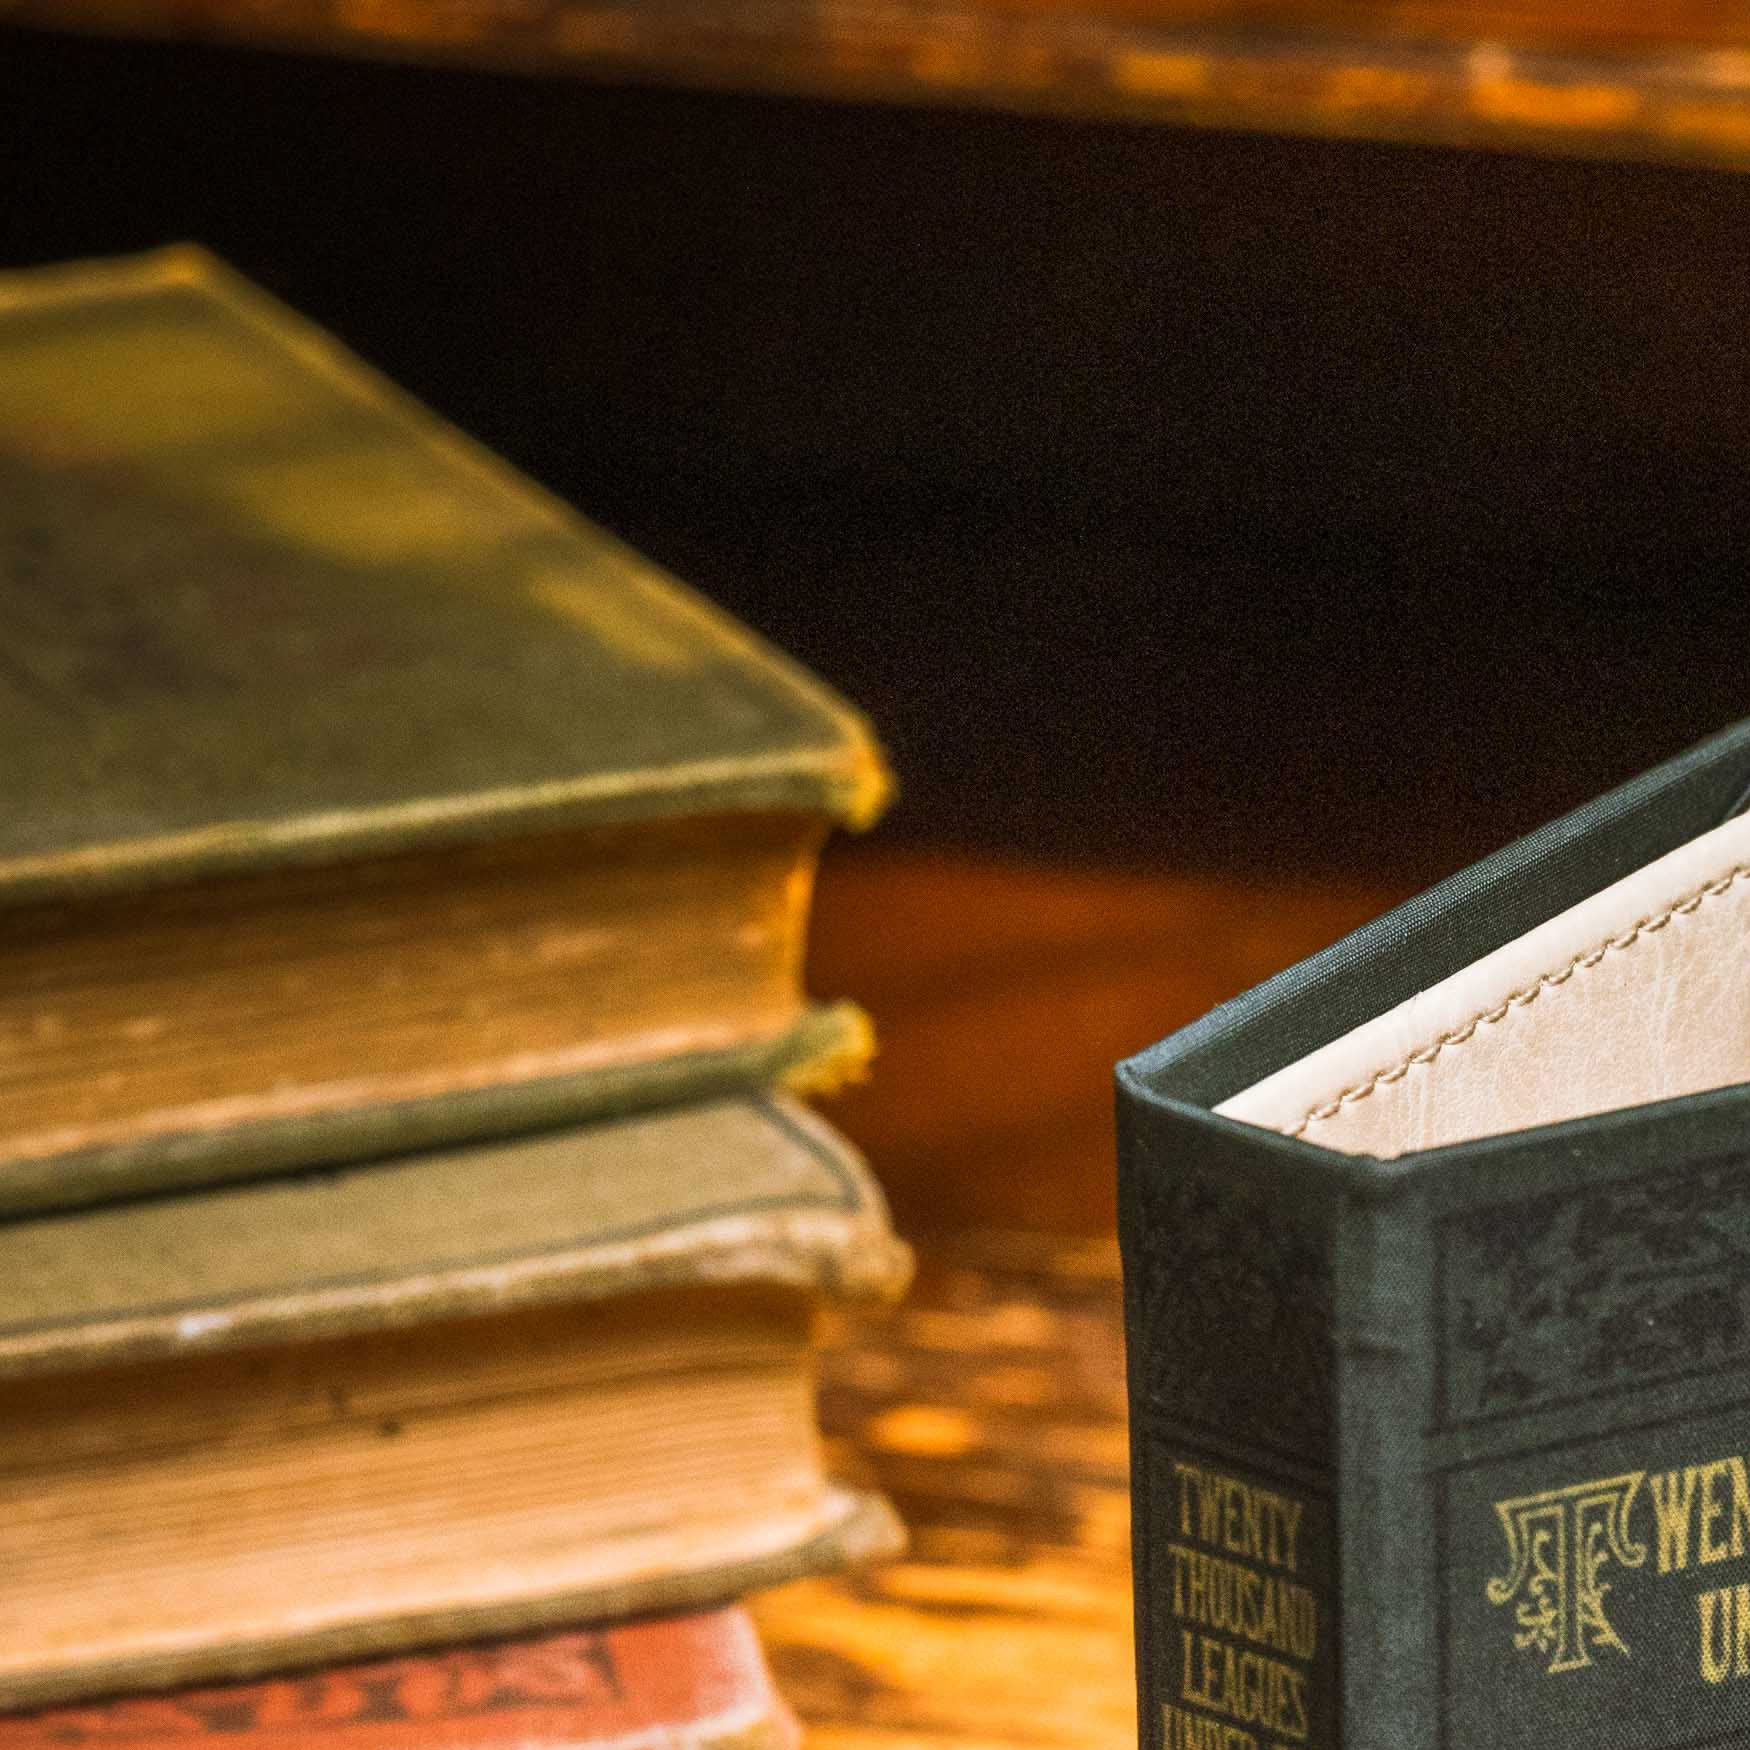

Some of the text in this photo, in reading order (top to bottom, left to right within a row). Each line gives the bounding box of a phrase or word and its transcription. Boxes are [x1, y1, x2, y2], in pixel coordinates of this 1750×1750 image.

[1173, 1461, 1303, 1571] TWENTY
[1167, 1543, 1317, 1660] THOUSAND
[1181, 1629, 1309, 1741] LEAGUES
